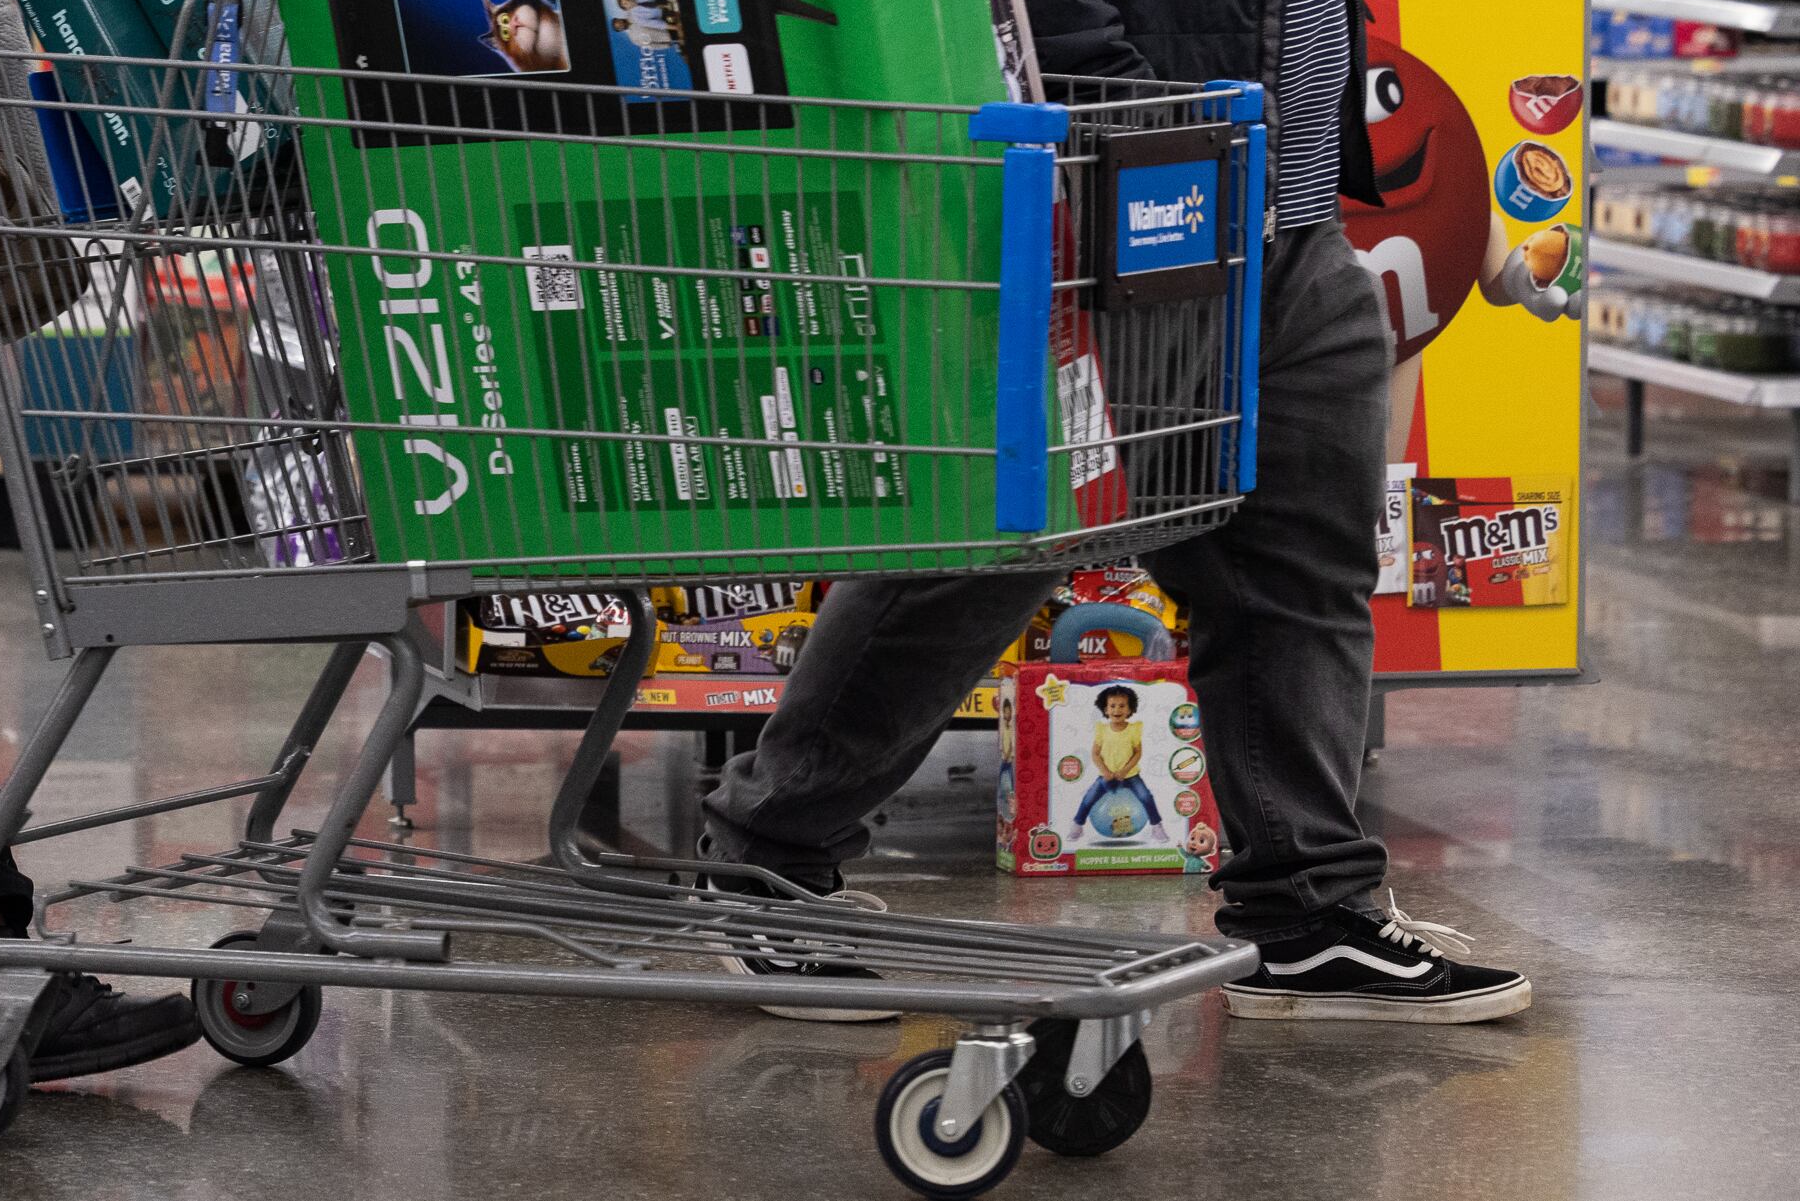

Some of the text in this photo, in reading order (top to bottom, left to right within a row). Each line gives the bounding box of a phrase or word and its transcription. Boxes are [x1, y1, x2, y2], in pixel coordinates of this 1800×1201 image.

[31, 14, 47, 38] Mount
[722, 52, 737, 91] NETFLIX
[781, 210, 797, 249] display
[1128, 197, 1185, 231] Walmart
[367, 208, 469, 515] VIZIO
[686, 423, 707, 495] FULL ARAY
[821, 450, 836, 498] Hundred
[1522, 549, 1549, 565] MIX
[660, 630, 753, 648] NUT BROWNIE MIX
[650, 691, 670, 704] NEW
[742, 687, 777, 706] MIX
